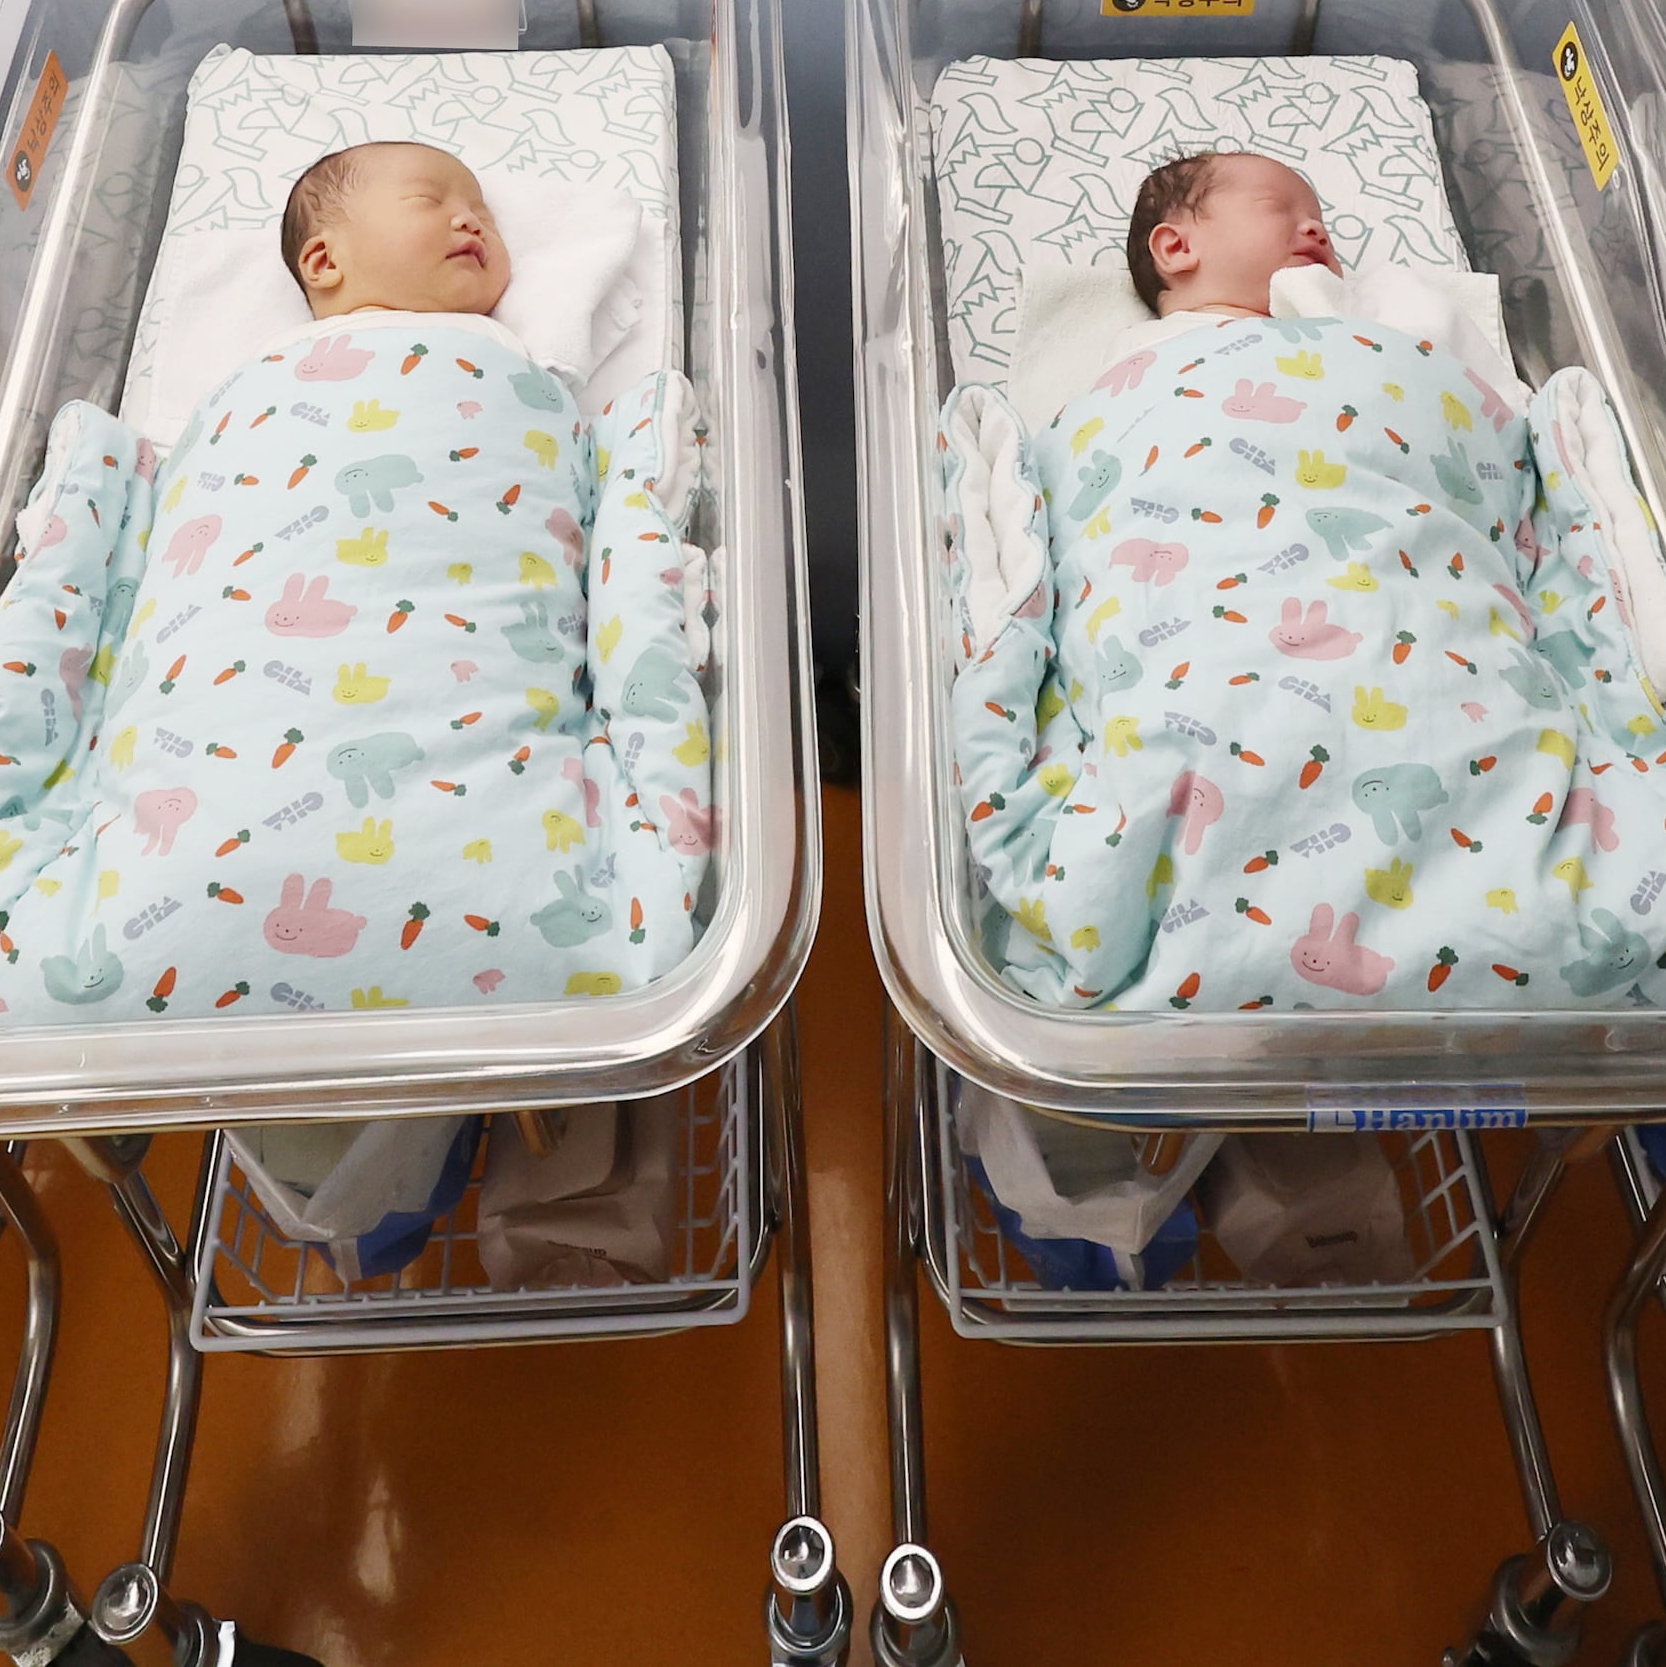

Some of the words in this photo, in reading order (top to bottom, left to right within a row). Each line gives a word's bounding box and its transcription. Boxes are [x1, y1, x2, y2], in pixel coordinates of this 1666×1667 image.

[26, 73, 64, 158] 낙상주의
[1574, 79, 1611, 172] 낙상주의
[1229, 437, 1277, 476] CHA
[274, 505, 330, 543] CHA
[1258, 543, 1310, 576] CHA
[1138, 617, 1192, 648] CHA
[263, 659, 313, 696] CHA
[1278, 675, 1332, 713] CHA
[155, 727, 194, 759] CHA
[263, 792, 325, 831] CHA
[1289, 823, 1351, 858] CHA
[124, 895, 184, 941] CHA
[1364, 1109, 1518, 1131] Hanlim
